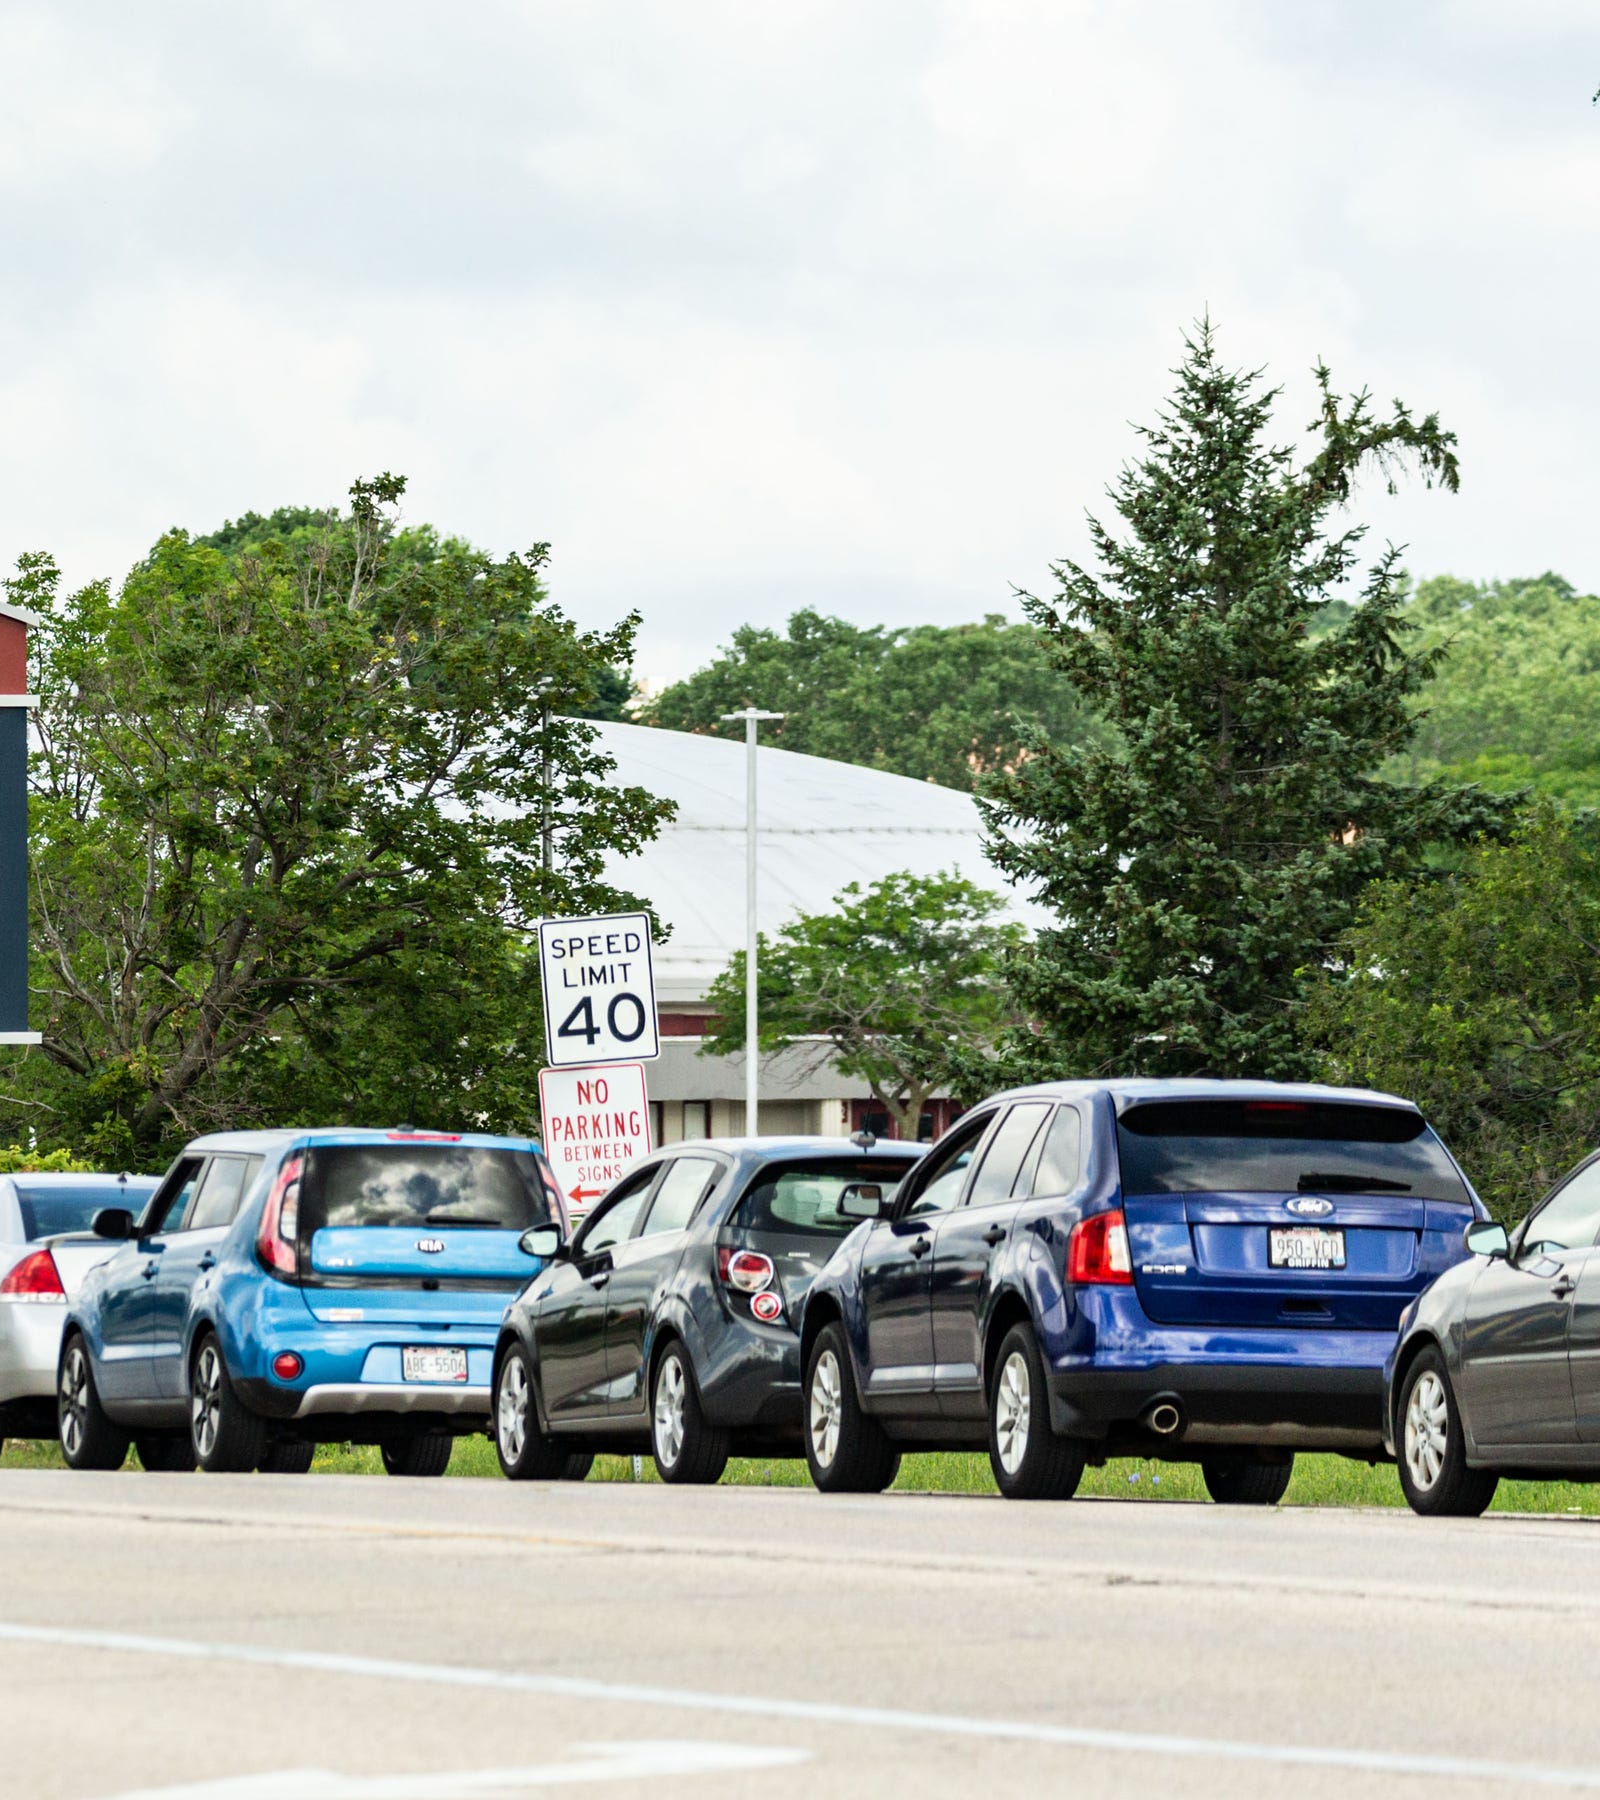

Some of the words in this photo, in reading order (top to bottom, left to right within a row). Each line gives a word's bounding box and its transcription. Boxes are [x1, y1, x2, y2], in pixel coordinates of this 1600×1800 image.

[551, 933, 640, 959] SPEED
[563, 963, 632, 988] LIMIT
[558, 992, 646, 1045] 40
[576, 1078, 609, 1105] NO
[552, 1110, 641, 1141] PARKING
[564, 1142, 633, 1162] BETWEEN
[578, 1163, 623, 1182] SIGNS
[418, 1239, 443, 1251] KIA
[406, 1357, 466, 1373] ABE-5506
